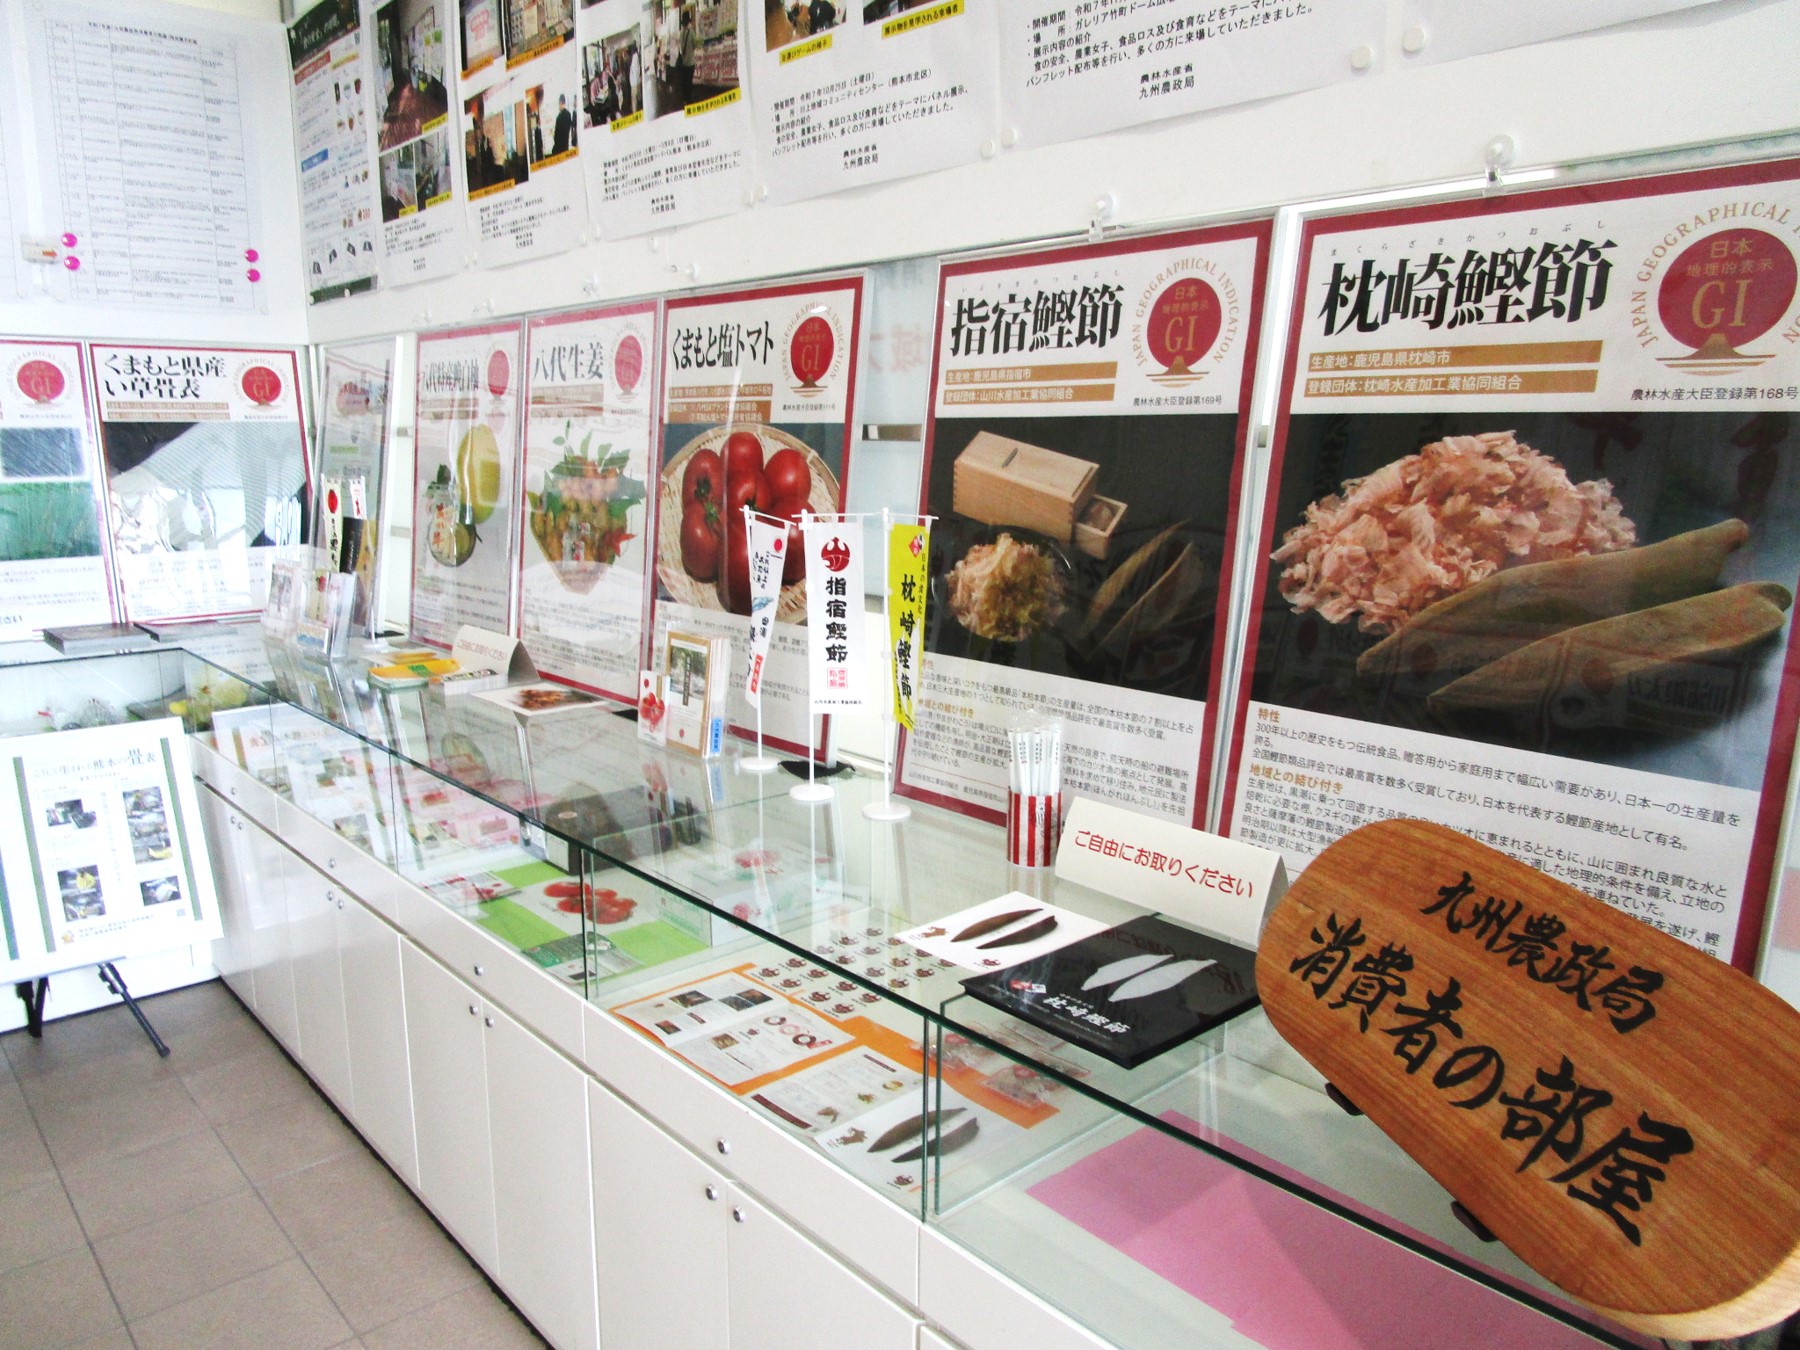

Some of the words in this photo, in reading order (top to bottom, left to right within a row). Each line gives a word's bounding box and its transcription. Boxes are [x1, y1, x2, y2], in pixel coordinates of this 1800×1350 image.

[1139, 75, 1196, 101] 九州農政局
[1140, 63, 1194, 85] 農林水産省
[843, 153, 879, 170] 九州農政局
[1636, 201, 1792, 283] GEOGRAPHICAL
[1710, 238, 1754, 259] 日本
[1686, 258, 1775, 278] 地理的表示
[1173, 286, 1198, 300] 日本
[1317, 237, 1619, 337] 枕崎鰹節
[1136, 256, 1217, 318] GEOGRAPHICAL
[1216, 273, 1240, 364] INDICATION
[1691, 279, 1754, 329] GI
[949, 282, 1125, 357] 指宿鰹節
[1631, 290, 1659, 348] JAPAN
[672, 320, 774, 370] くまもと塩トマト
[1163, 315, 1196, 353] GI
[104, 353, 228, 378] くまもと県産
[533, 341, 605, 383] 八代生姜
[801, 344, 820, 372] GI
[1310, 350, 1451, 370] 生産地：鹿児島県枕崎市
[105, 377, 201, 399] い草畳表
[252, 381, 271, 398] GI
[946, 369, 1032, 384] 生産地：鹿児島県指宿市
[1306, 375, 1524, 396] 登録団体：枕崎水産加工業協同組合
[1132, 395, 1223, 407] 農林水産大臣登録第169号
[1630, 386, 1799, 401] 農林水産大臣登録第168号
[825, 576, 849, 664] 指宿鰹節
[896, 573, 917, 701] 枕崎鰹節
[1258, 707, 1281, 723] 特性
[1250, 763, 1344, 795] 地域との結び付き
[1074, 829, 1254, 899] ご自由にお取りください
[1420, 870, 1666, 1036] 九州農政局
[1288, 911, 1694, 1247] 消費者の部屋
